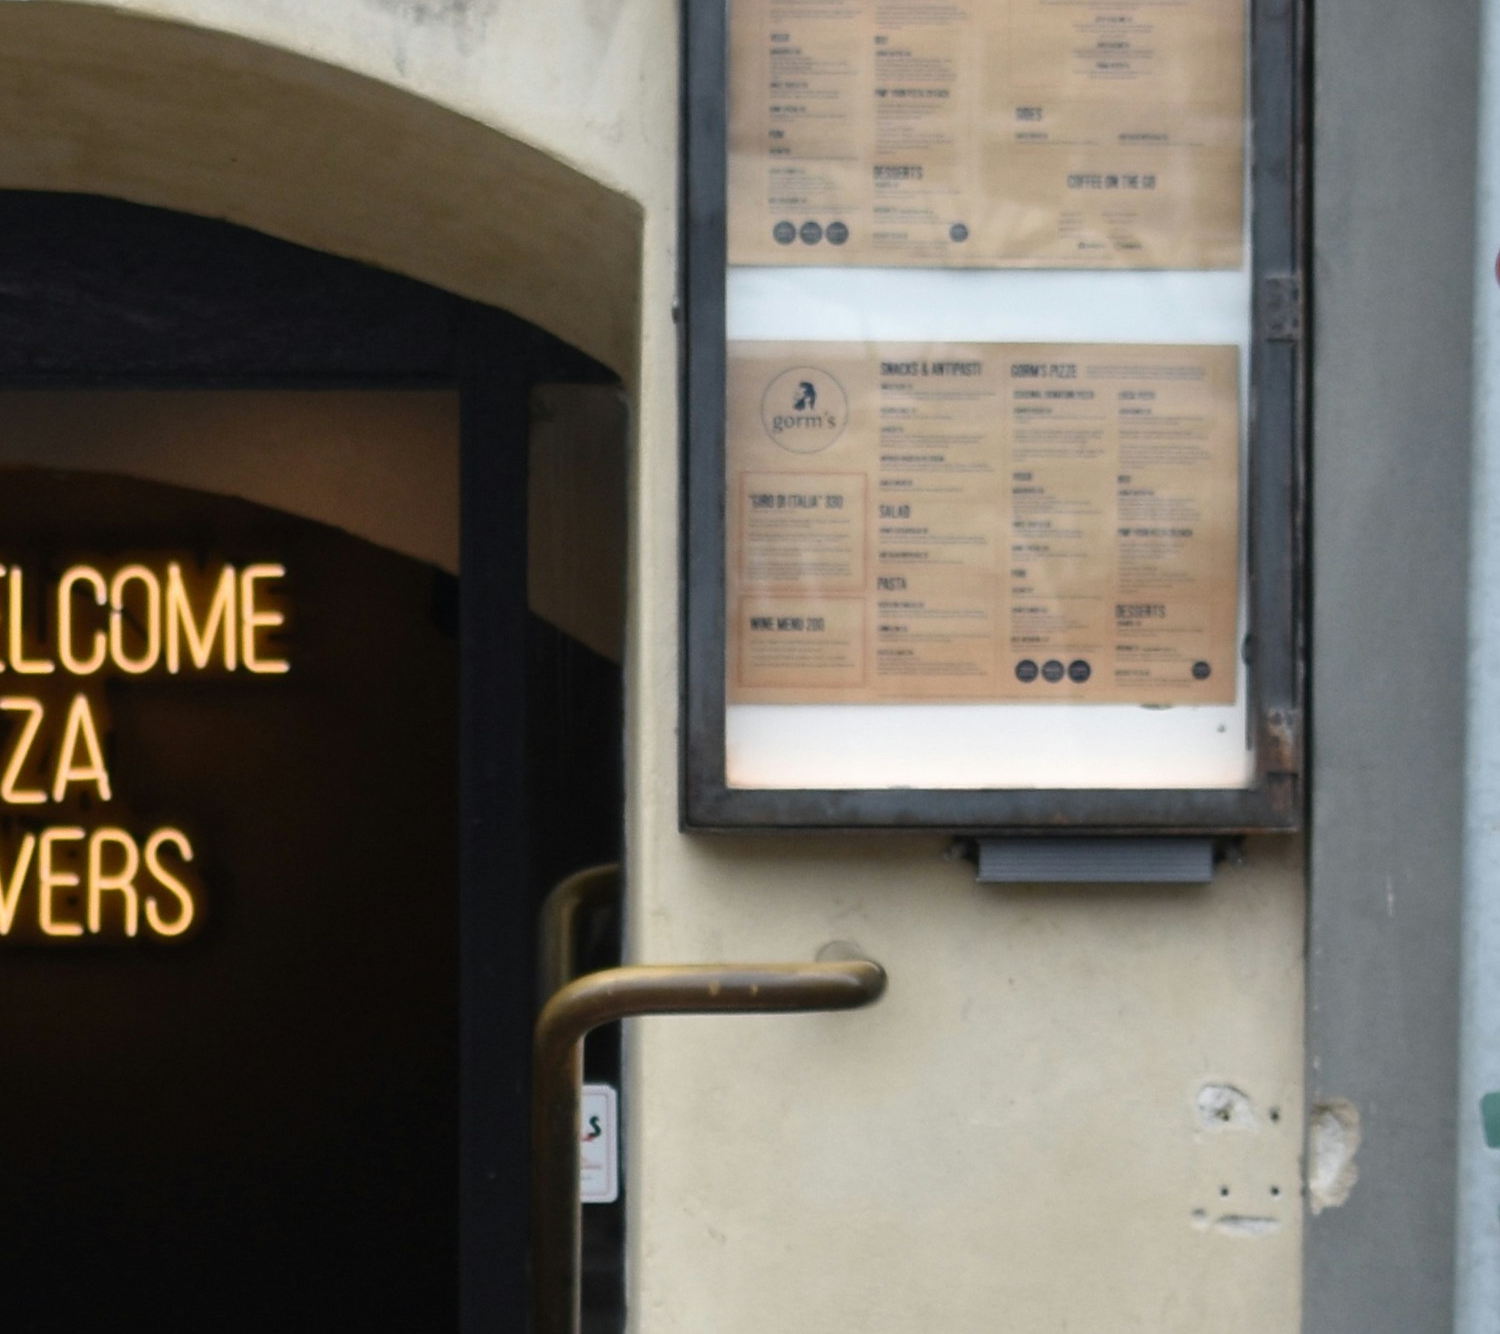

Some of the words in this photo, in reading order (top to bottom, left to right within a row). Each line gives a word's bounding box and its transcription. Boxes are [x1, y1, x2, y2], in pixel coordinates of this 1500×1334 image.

[873, 165, 923, 181] DESSERTS
[1067, 175, 1102, 190] COFFEE
[1122, 175, 1138, 190] THE
[880, 362, 919, 377] SNACKS
[931, 362, 982, 377] ANTIPASTI
[1010, 364, 1047, 379] GORM'S
[1049, 364, 1078, 379] PIZZE
[772, 412, 837, 434] gorm's
[879, 505, 911, 519] SALAD
[877, 576, 907, 591] PASTA
[1115, 604, 1166, 619] DESSERTS
[749, 617, 775, 632] WINE
[776, 617, 804, 632] MENU
